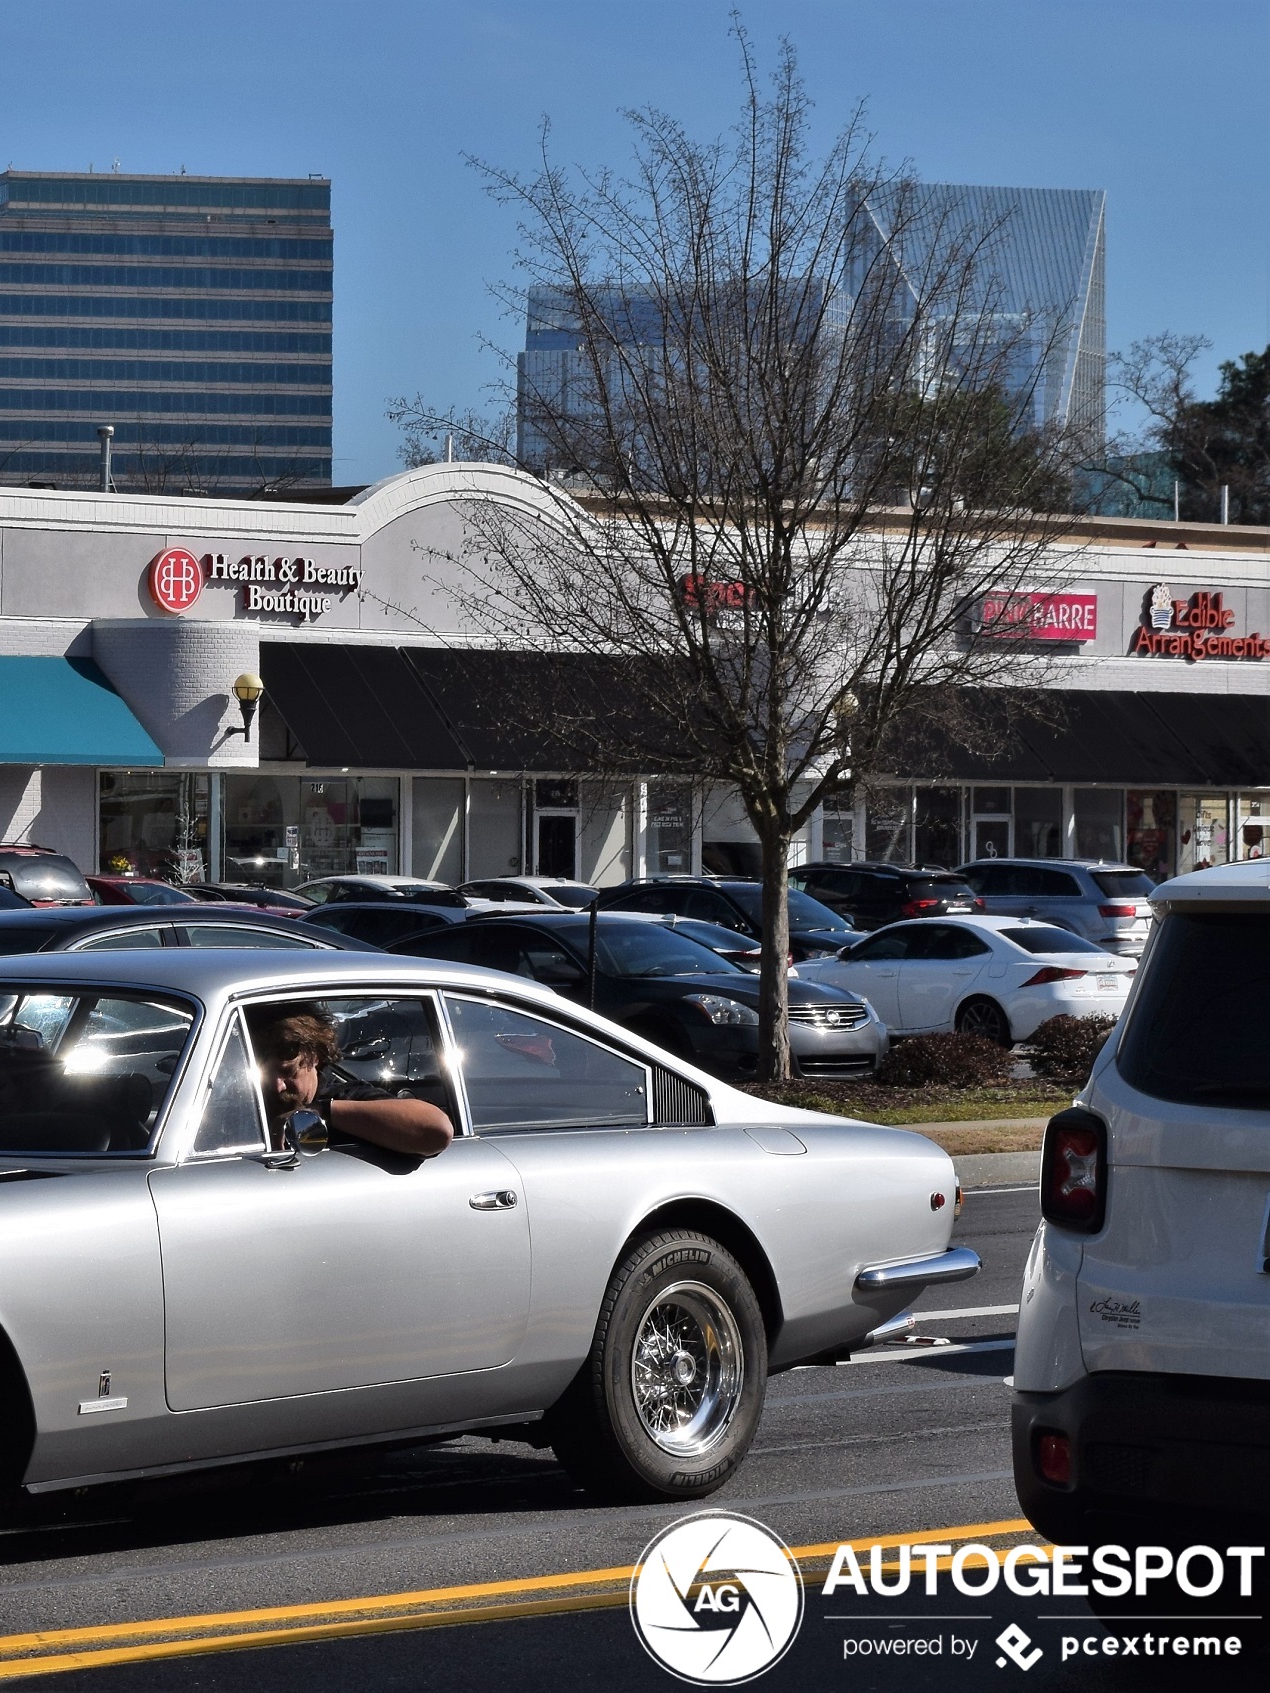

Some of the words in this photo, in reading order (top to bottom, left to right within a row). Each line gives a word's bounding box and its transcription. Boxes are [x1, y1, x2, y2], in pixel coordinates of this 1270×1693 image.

[210, 554, 275, 581] Health
[278, 557, 299, 583] &
[302, 558, 365, 593] Beauty
[247, 585, 331, 622] Boutique
[1175, 592, 1235, 628] Edible
[1135, 626, 1270, 660] Arrangements
[652, 1250, 709, 1276] MICHELIN
[674, 1458, 729, 1485] MICHELIN
